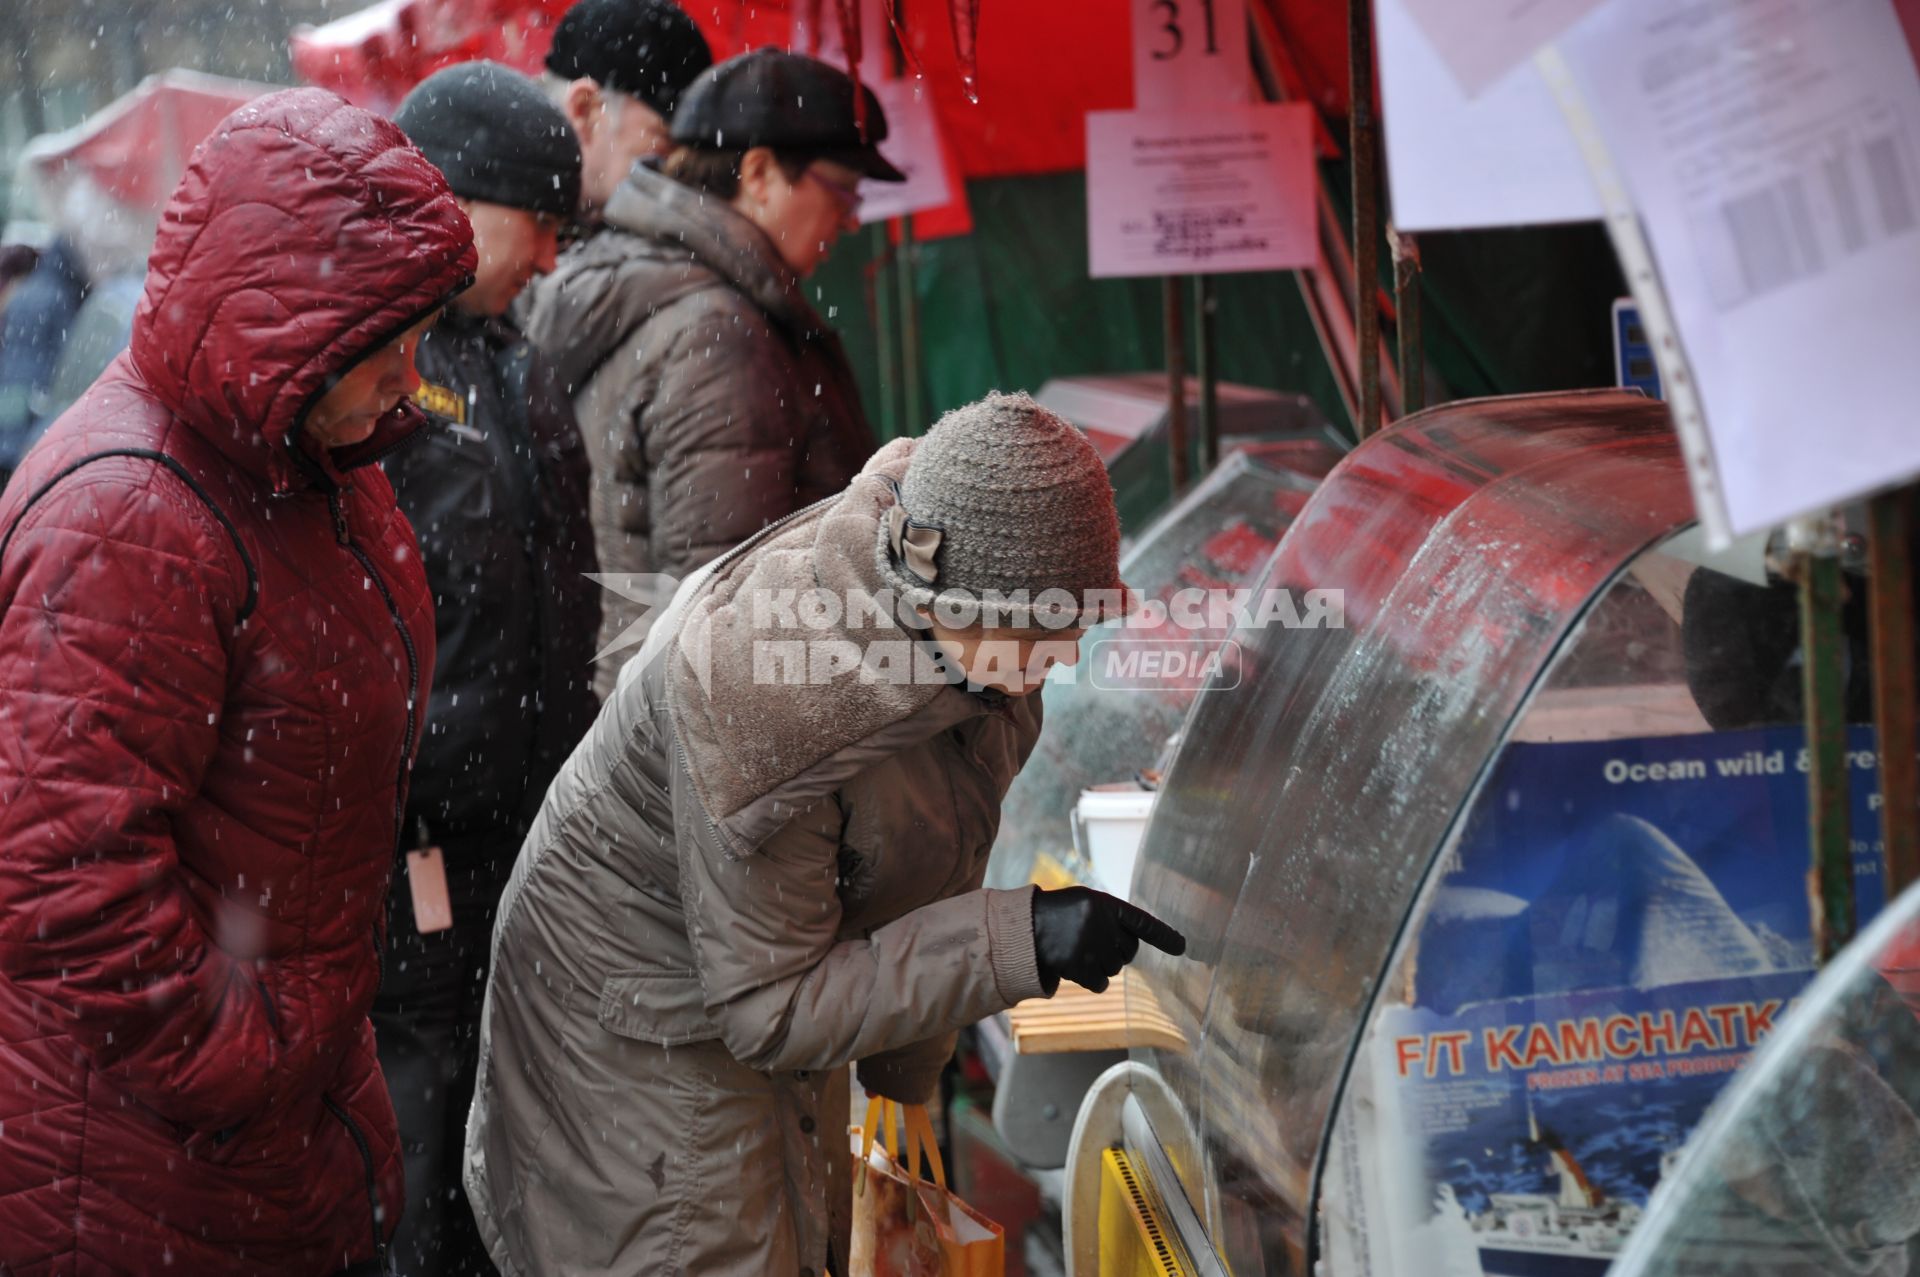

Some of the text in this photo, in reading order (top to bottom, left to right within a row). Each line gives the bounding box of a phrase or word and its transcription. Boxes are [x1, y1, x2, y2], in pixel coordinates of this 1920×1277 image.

[1150, 0, 1219, 60] 31
[1604, 759, 1706, 783] Ocean
[1716, 751, 1784, 777] wild
[1395, 999, 1794, 1079] F/T KAMCHATK
[1527, 1069, 1600, 1090] FROZEN
[1603, 1065, 1626, 1083] AT
[1629, 1061, 1665, 1081] SEA
